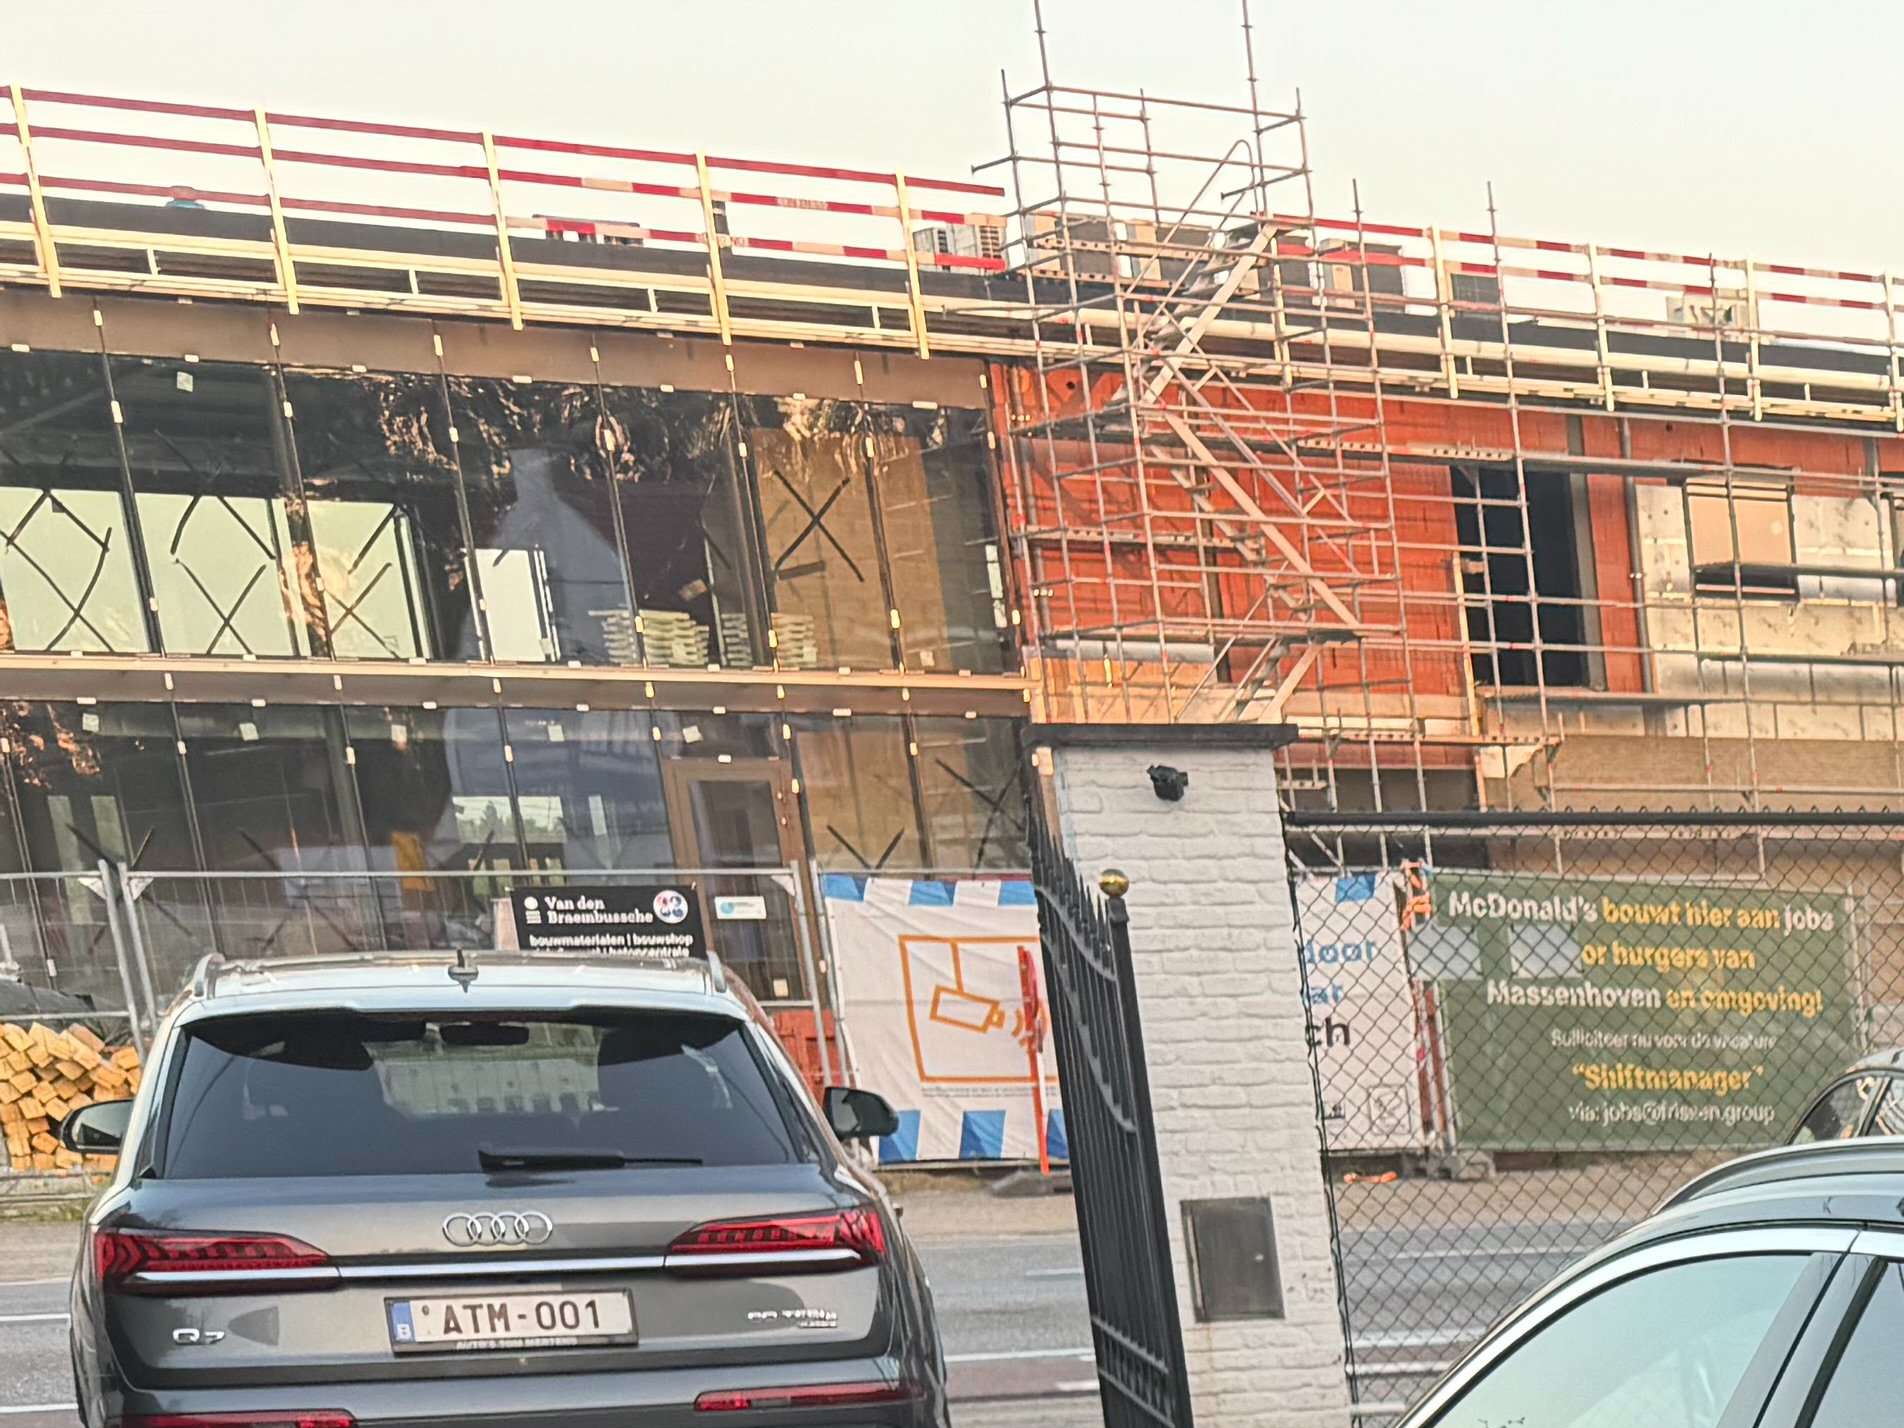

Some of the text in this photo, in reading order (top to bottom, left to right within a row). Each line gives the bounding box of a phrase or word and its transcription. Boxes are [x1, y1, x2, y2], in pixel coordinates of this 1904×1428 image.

[545, 895, 605, 911] Van den
[1449, 890, 1835, 937] McDonald's bouwt hier aan jobs
[1712, 949, 1756, 970] van
[1487, 978, 1824, 1019] Massenhoven en omgeving!
[443, 1299, 600, 1336] ATM-001
